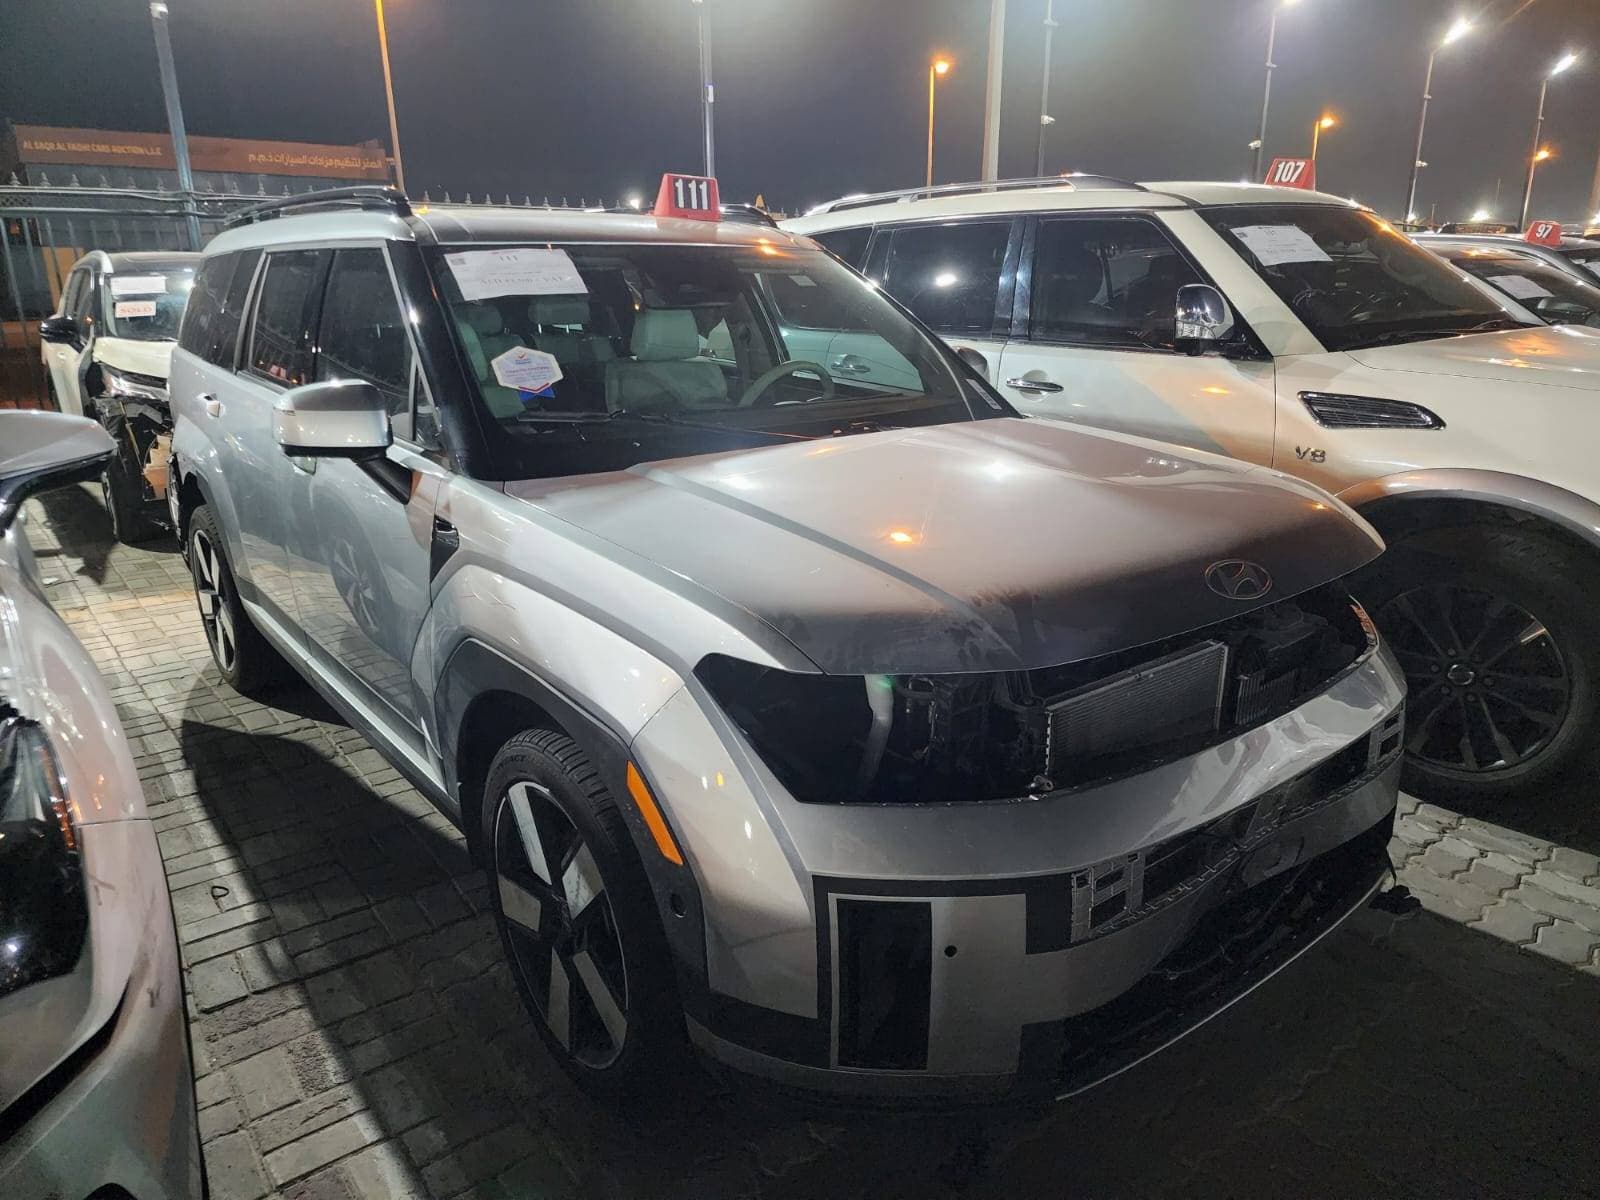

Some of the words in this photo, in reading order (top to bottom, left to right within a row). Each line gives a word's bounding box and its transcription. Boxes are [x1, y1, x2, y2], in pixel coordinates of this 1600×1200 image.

[1274, 161, 1305, 183] 107
[675, 178, 708, 210] 111
[1535, 223, 1553, 239] 97
[1295, 445, 1326, 463] V8
